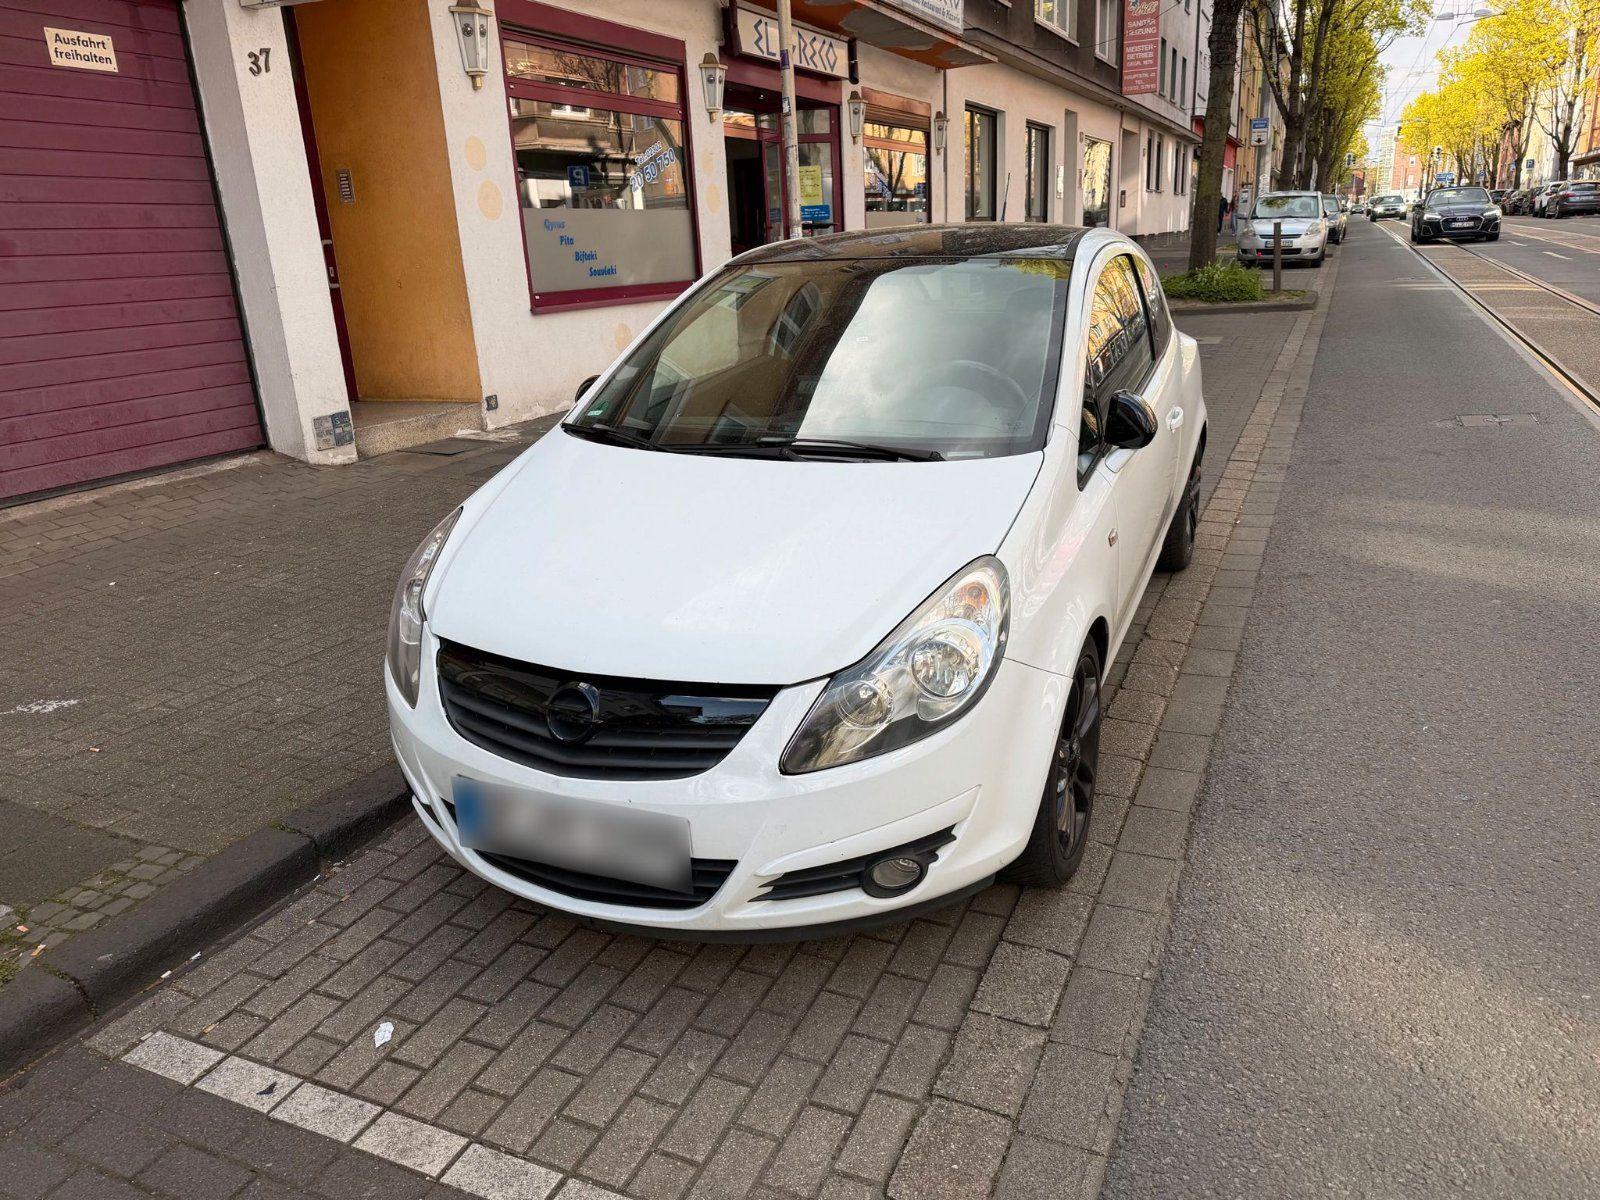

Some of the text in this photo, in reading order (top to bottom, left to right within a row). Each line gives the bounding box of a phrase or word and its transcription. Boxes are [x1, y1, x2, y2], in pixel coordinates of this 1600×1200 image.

[54, 33, 106, 49] Ausfahrt
[753, 18, 837, 72] EL RECO
[54, 47, 112, 64] freihalten
[247, 48, 271, 76] 37
[630, 148, 675, 192] 20 50 750
[560, 235, 574, 245] Pita
[575, 250, 597, 263] Bifteki
[589, 265, 616, 277] Souvlaki
